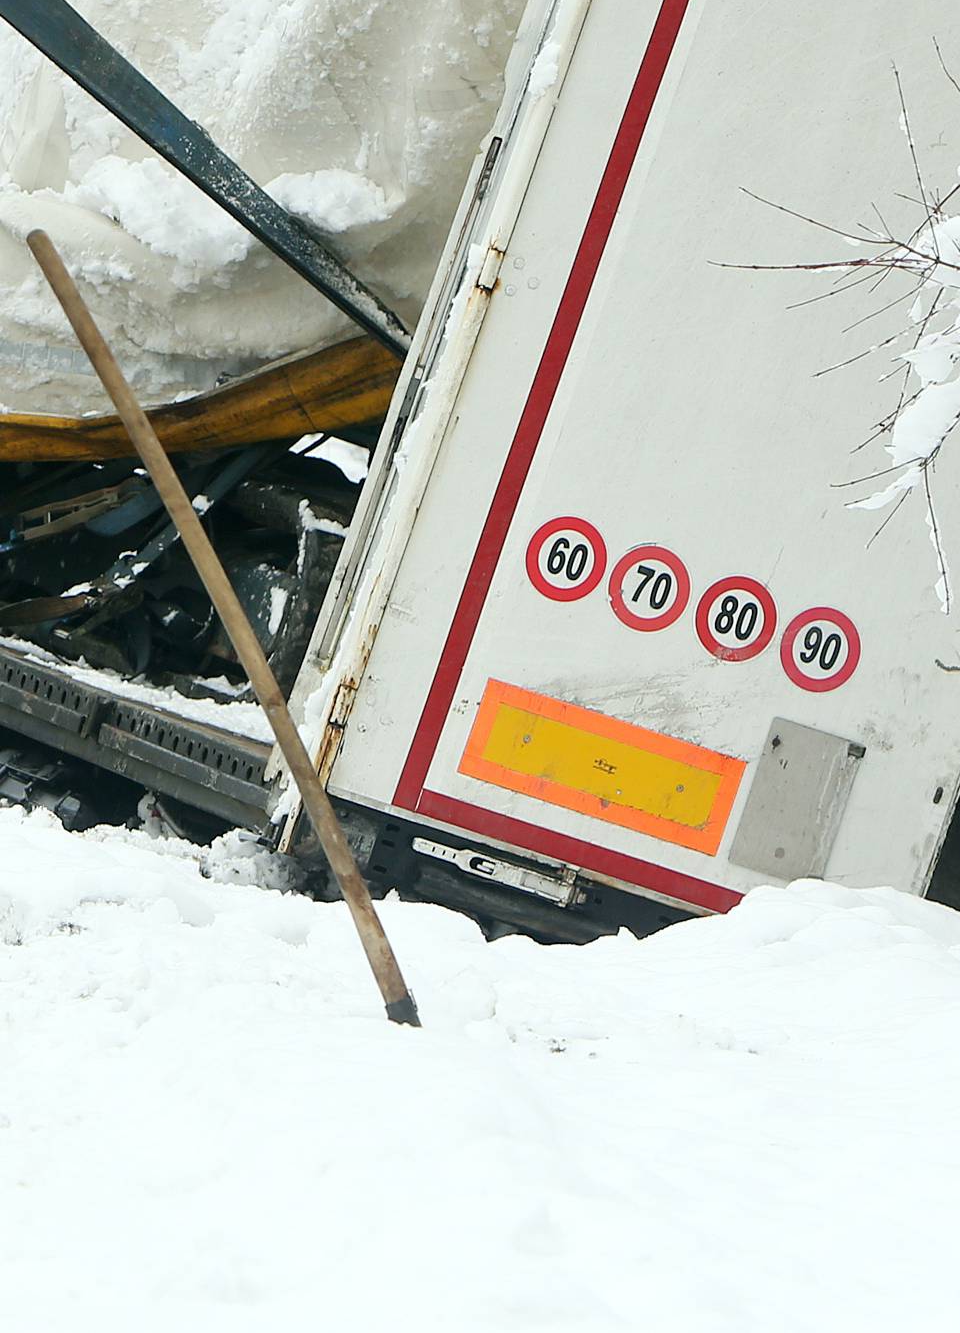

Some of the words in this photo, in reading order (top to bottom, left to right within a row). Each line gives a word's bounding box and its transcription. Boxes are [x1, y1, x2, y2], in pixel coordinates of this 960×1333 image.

[547, 537, 588, 581] 60
[632, 565, 672, 611] 70
[714, 595, 758, 641] 80
[799, 626, 842, 671] 90
